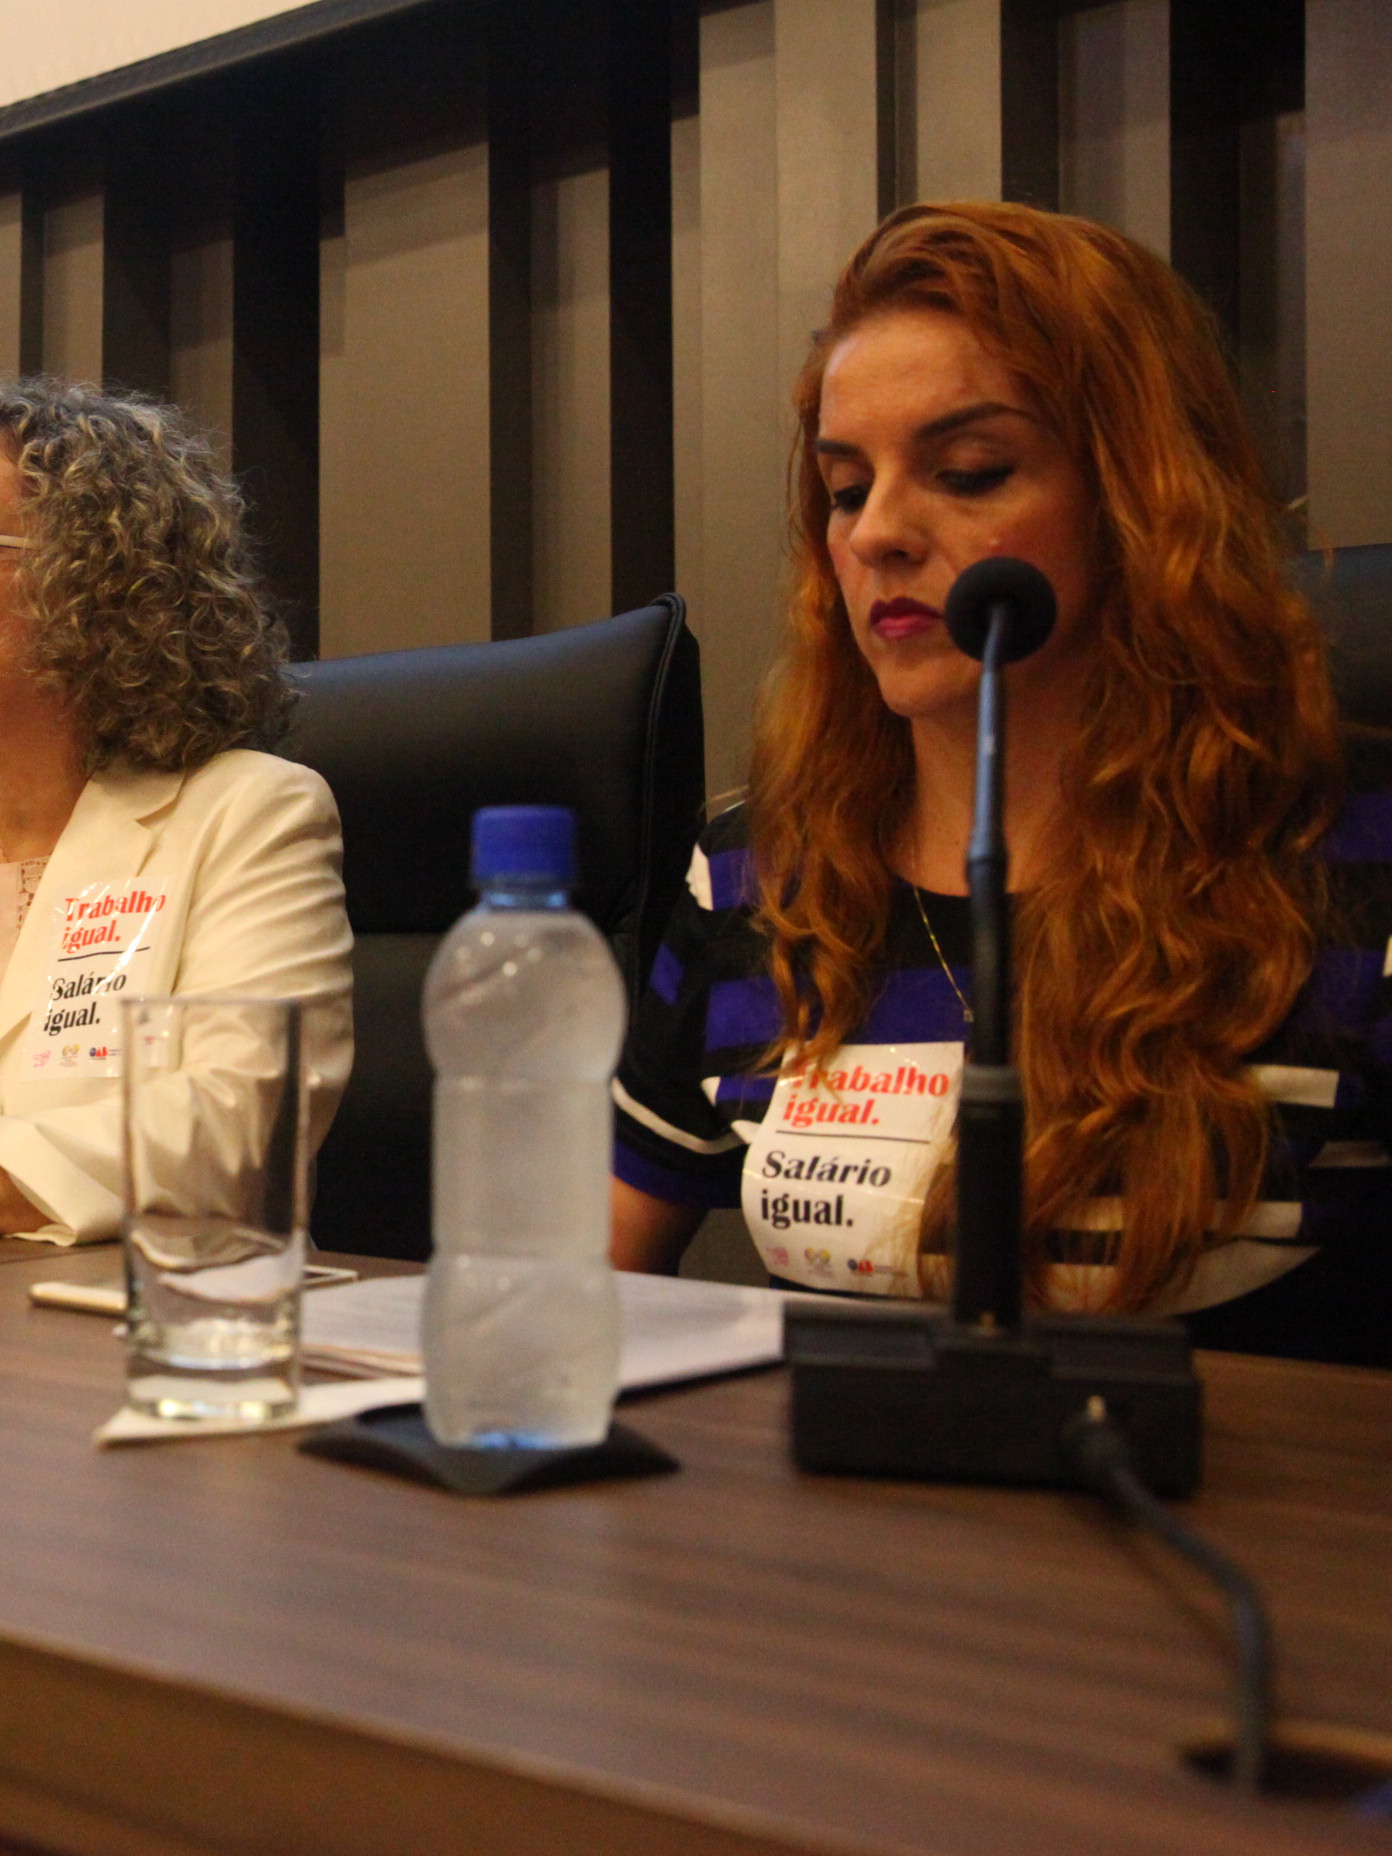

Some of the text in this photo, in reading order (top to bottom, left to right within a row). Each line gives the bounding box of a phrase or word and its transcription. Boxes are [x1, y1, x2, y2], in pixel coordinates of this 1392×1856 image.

[65, 891, 166, 921] Trabalho
[62, 920, 121, 954] igual.
[44, 1001, 101, 1036] igual.
[783, 1094, 880, 1128] igual.
[762, 1150, 891, 1188] Salário
[761, 1189, 854, 1230] igual.
